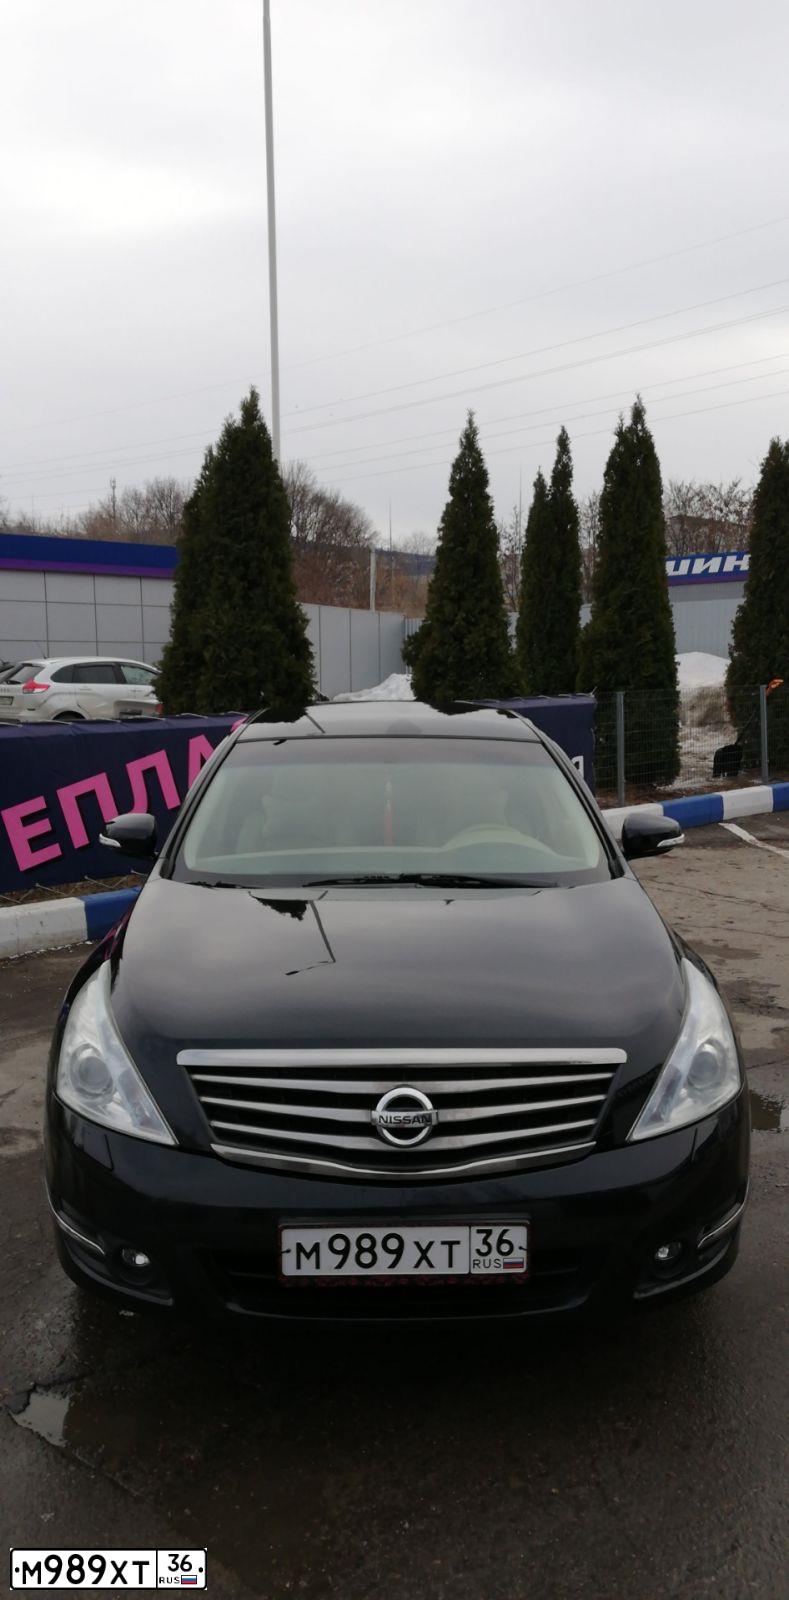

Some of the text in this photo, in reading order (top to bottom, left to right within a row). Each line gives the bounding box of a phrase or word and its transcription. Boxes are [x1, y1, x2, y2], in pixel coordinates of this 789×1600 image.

[379, 1115, 431, 1125] NISSAN
[475, 1228, 515, 1257] 36
[472, 1258, 502, 1269] RUS
